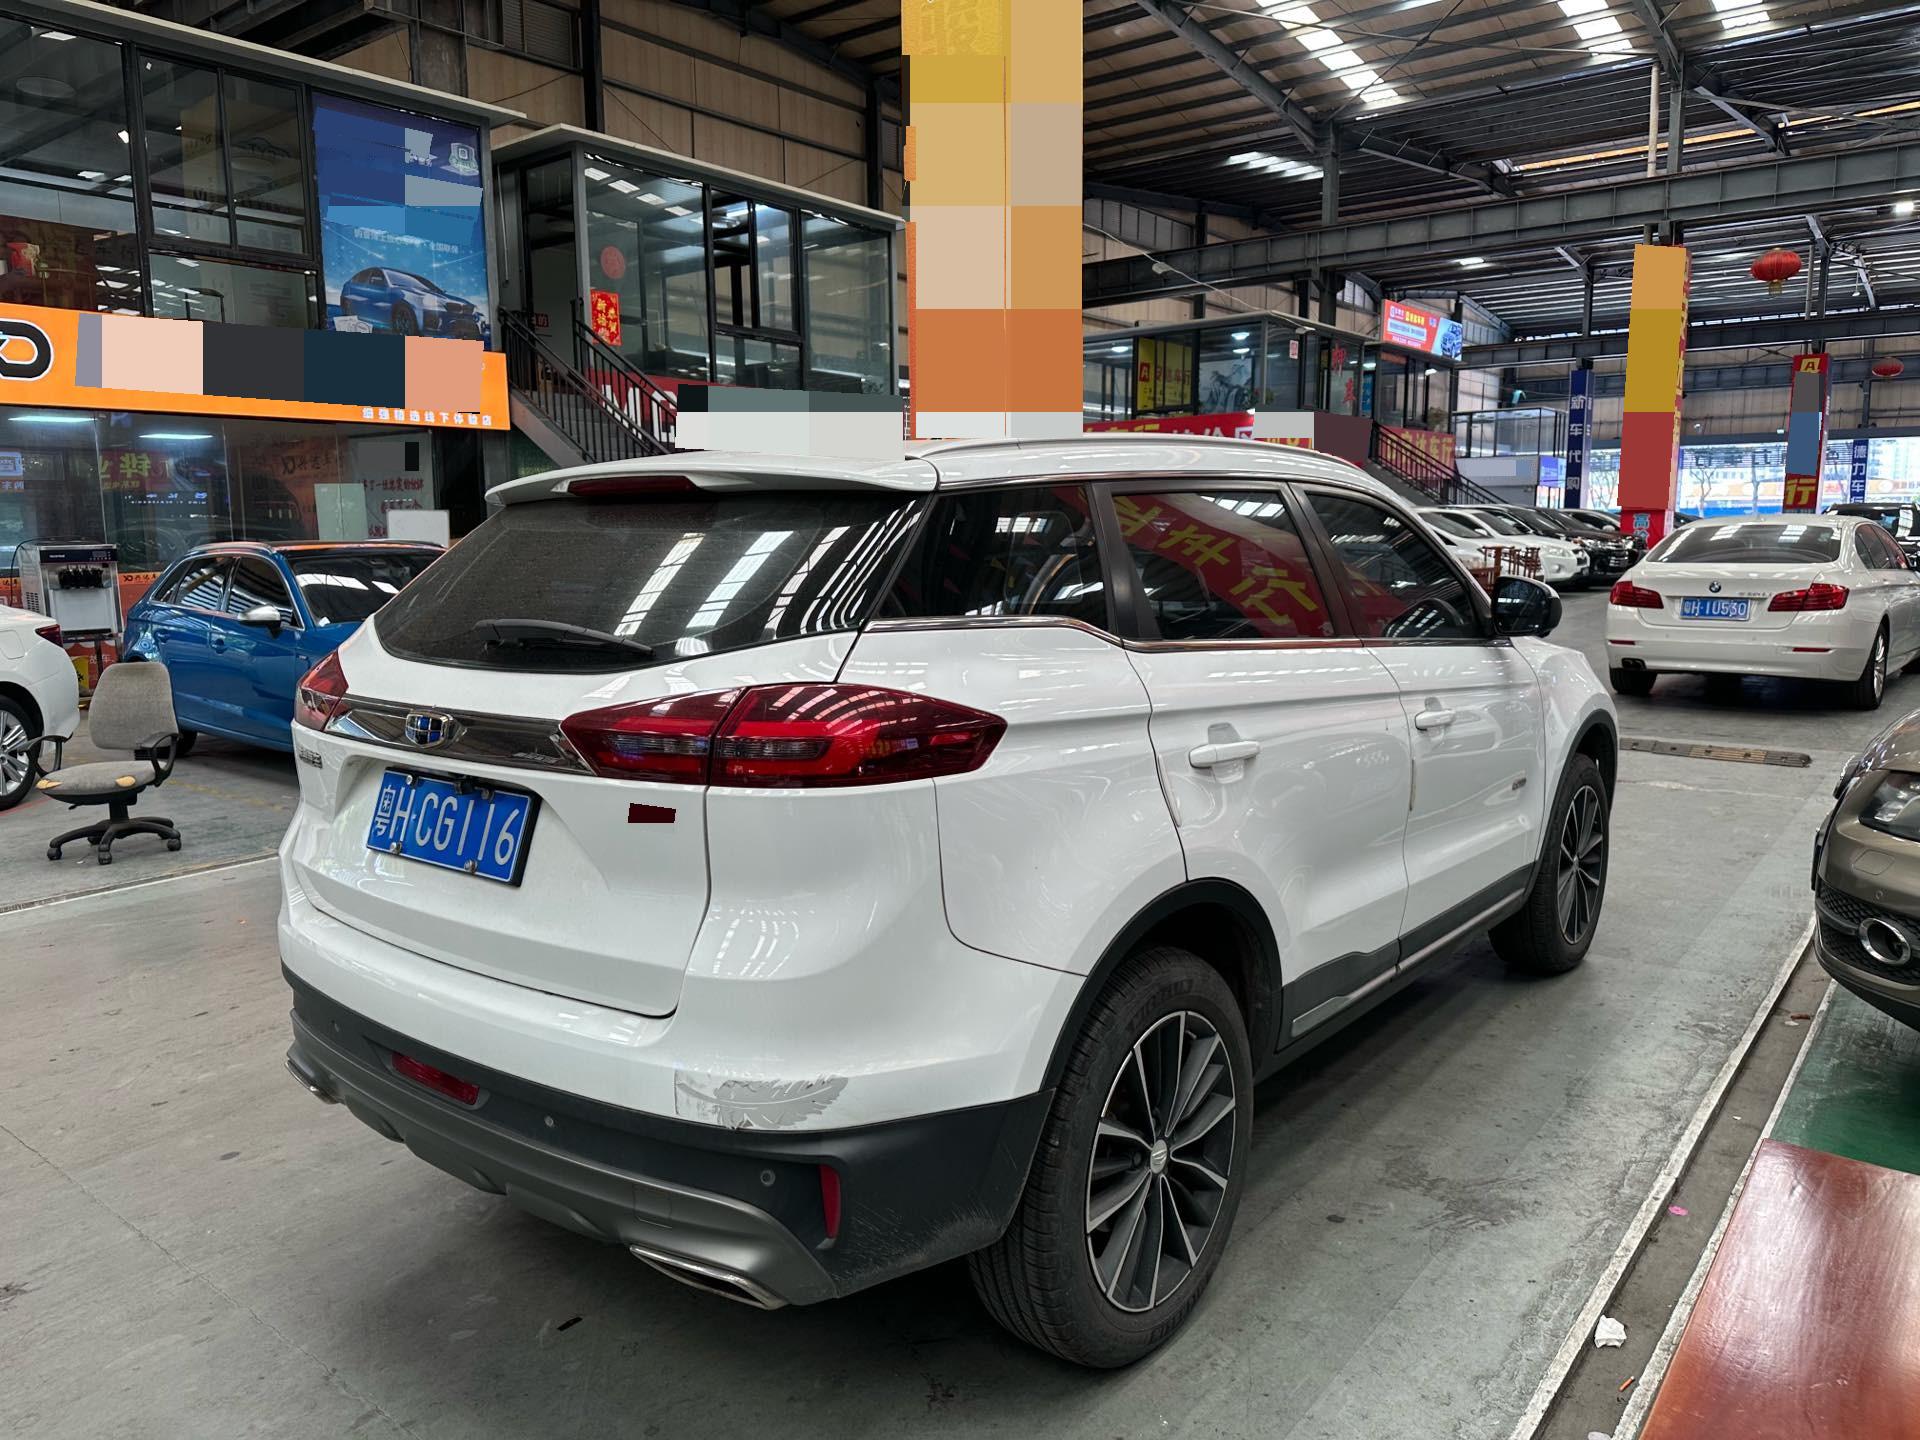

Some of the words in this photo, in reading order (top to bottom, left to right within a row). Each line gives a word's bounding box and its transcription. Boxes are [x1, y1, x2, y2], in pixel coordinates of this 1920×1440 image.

[1566, 395, 1587, 491] 新车代购
[1785, 478, 1817, 506] 行
